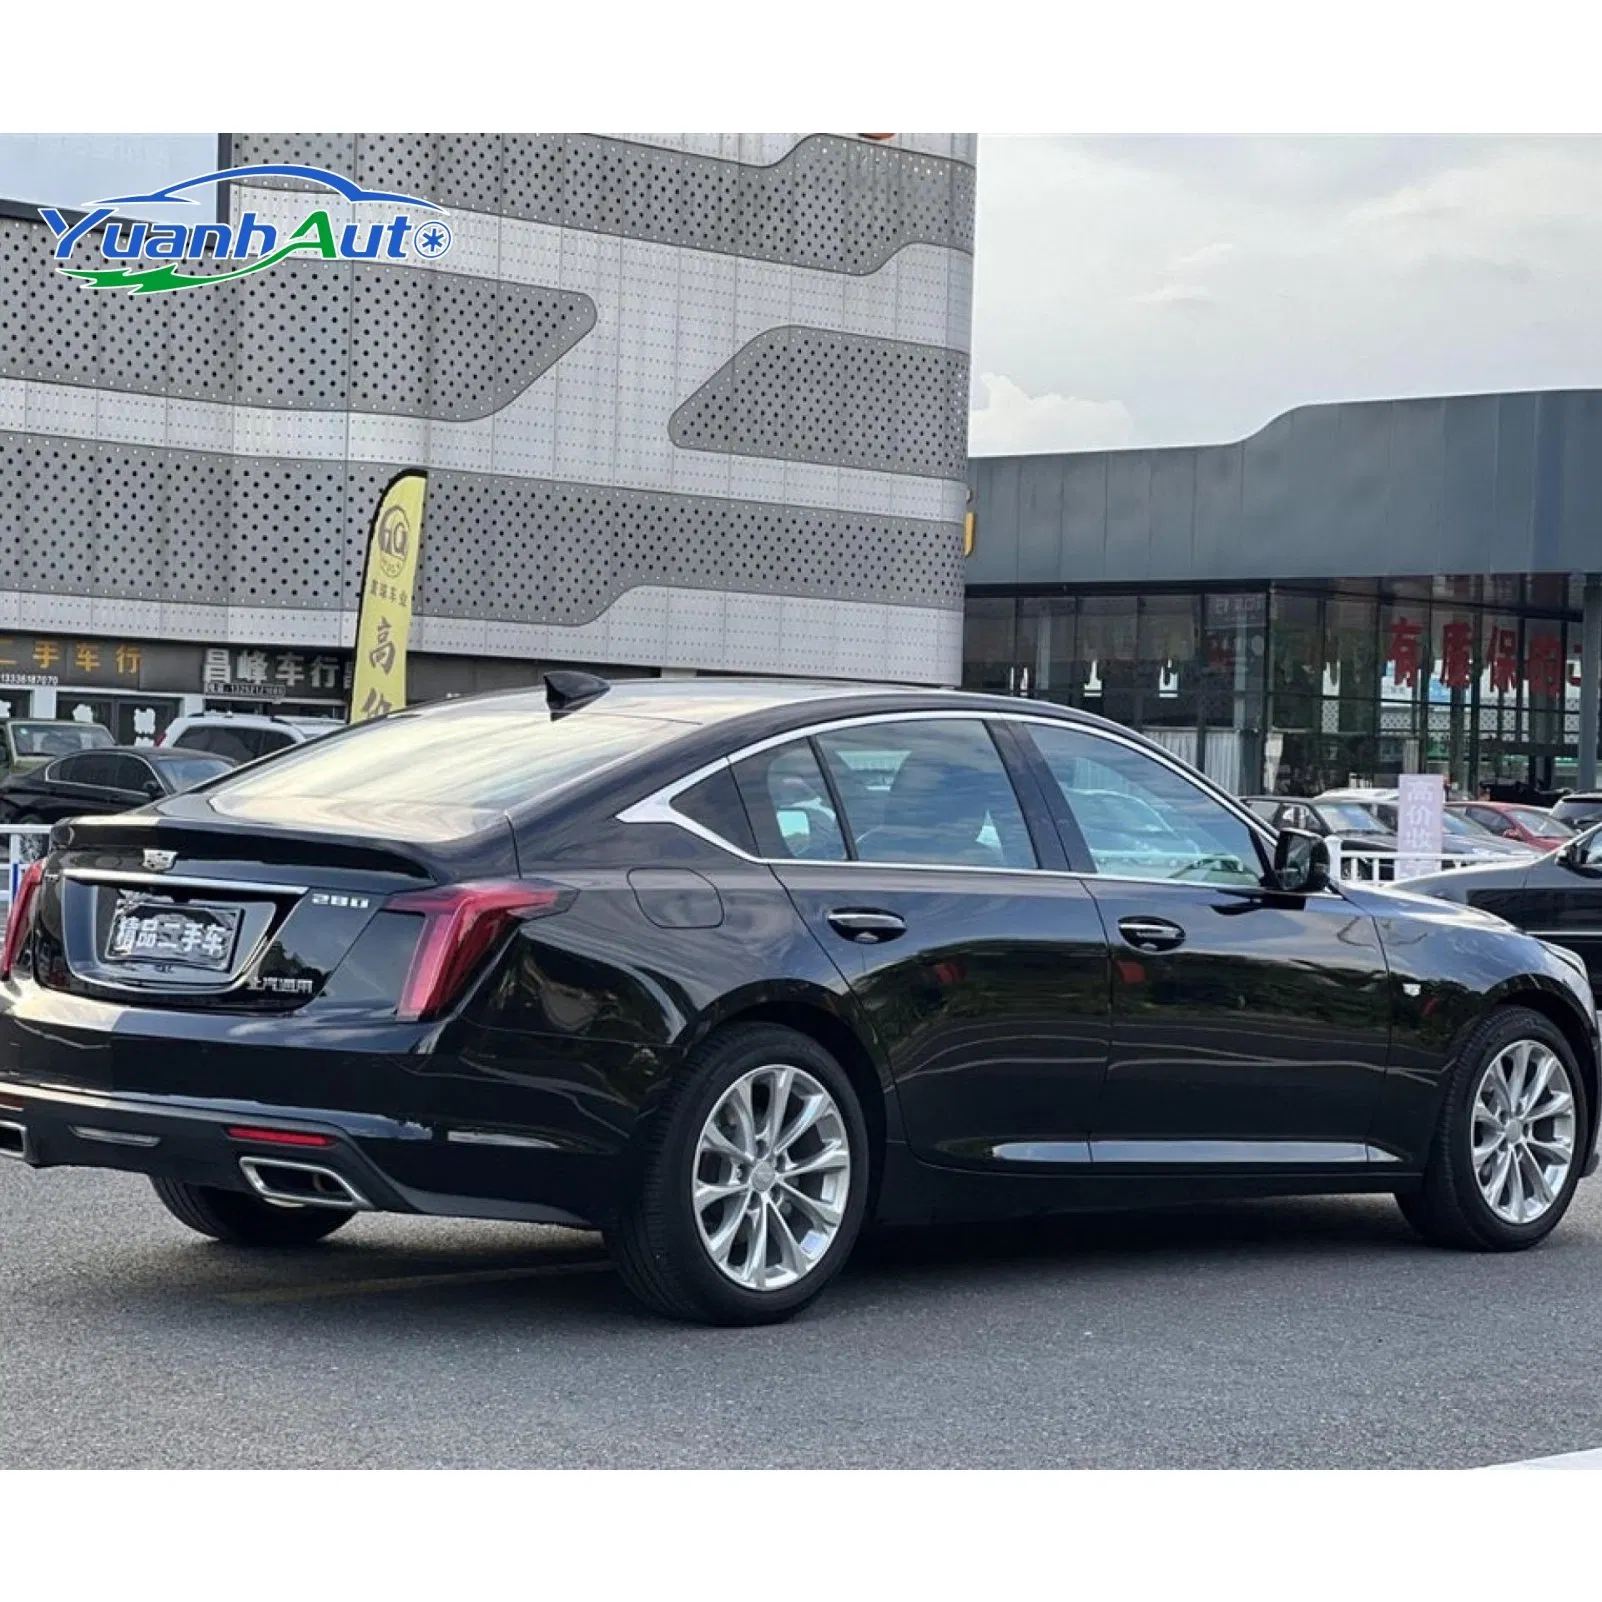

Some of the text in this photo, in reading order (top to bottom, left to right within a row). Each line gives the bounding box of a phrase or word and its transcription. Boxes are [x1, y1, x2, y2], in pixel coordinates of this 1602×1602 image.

[115, 915, 228, 957] 精品二手车
